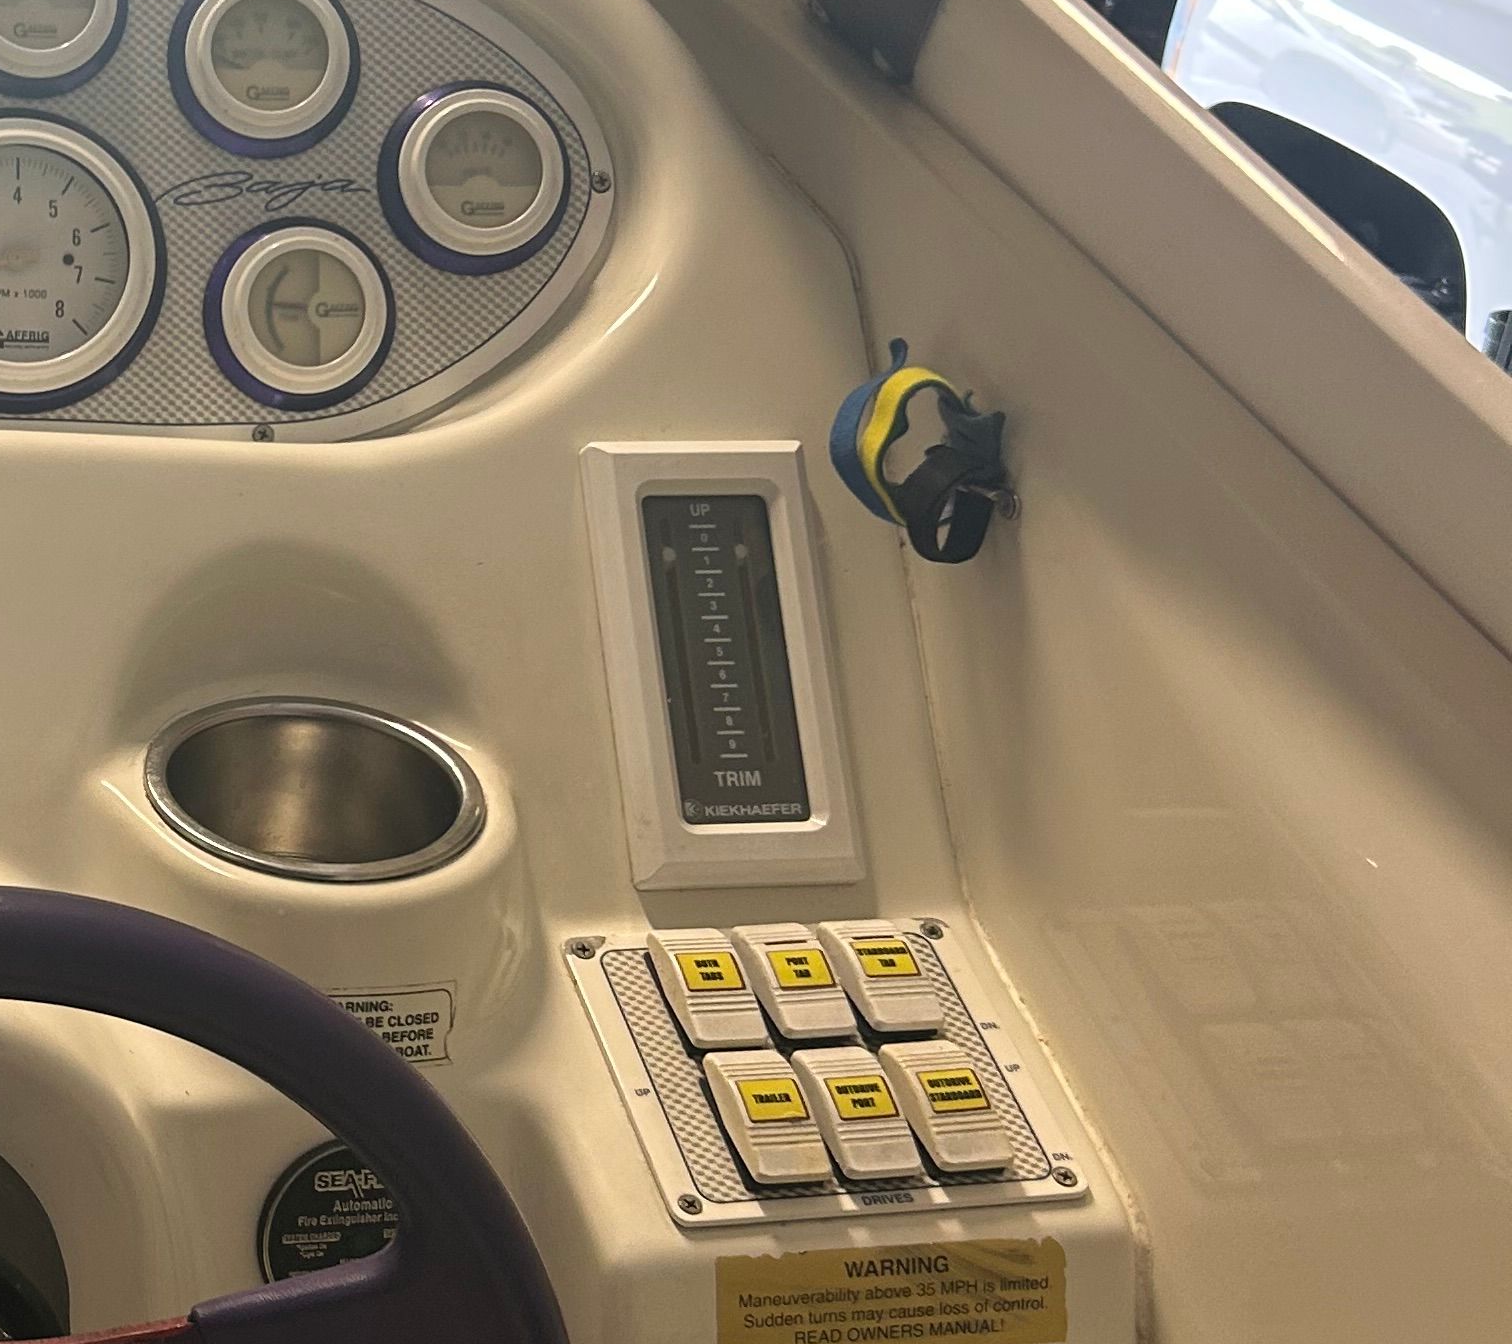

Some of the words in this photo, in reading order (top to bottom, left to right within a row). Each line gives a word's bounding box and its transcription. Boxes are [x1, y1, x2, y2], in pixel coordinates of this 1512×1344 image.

[13, 186, 22, 204] 4
[48, 199, 58, 218] 5
[72, 228, 81, 246] 6
[75, 265, 83, 284] 7
[23, 289, 47, 298] 1000
[55, 300, 65, 318] 8
[690, 503, 710, 516] UP
[706, 578, 714, 587] 2
[710, 600, 717, 610] 3
[713, 623, 721, 633] 4
[716, 646, 723, 656] 5
[719, 669, 726, 679] 6
[722, 693, 729, 703] 7
[729, 739, 736, 749] 9
[714, 771, 762, 787] TRIM
[704, 802, 802, 817] KIEKHAEFER
[388, 1011, 440, 1027] CLOSED
[382, 1027, 434, 1043] BEFORE
[333, 1197, 393, 1213] Automatic
[861, 1193, 914, 1206] DRIVES
[297, 1215, 318, 1227] Fire
[844, 1256, 949, 1278] WARNING
[738, 1288, 860, 1309] Maneuverability
[865, 1283, 912, 1301] above
[915, 1281, 935, 1297] 35
[940, 1279, 978, 1296] MPH
[983, 1279, 995, 1293] is
[744, 1311, 803, 1329] Sudden
[808, 1309, 846, 1324] turns
[851, 1308, 885, 1326] may
[889, 1304, 934, 1320] cause
[939, 1301, 969, 1316] loss
[974, 1298, 989, 1314] of
[993, 1296, 1048, 1313] control.
[847, 1323, 924, 1342] OWNERS
[929, 1319, 1005, 1337] MANUAL!
